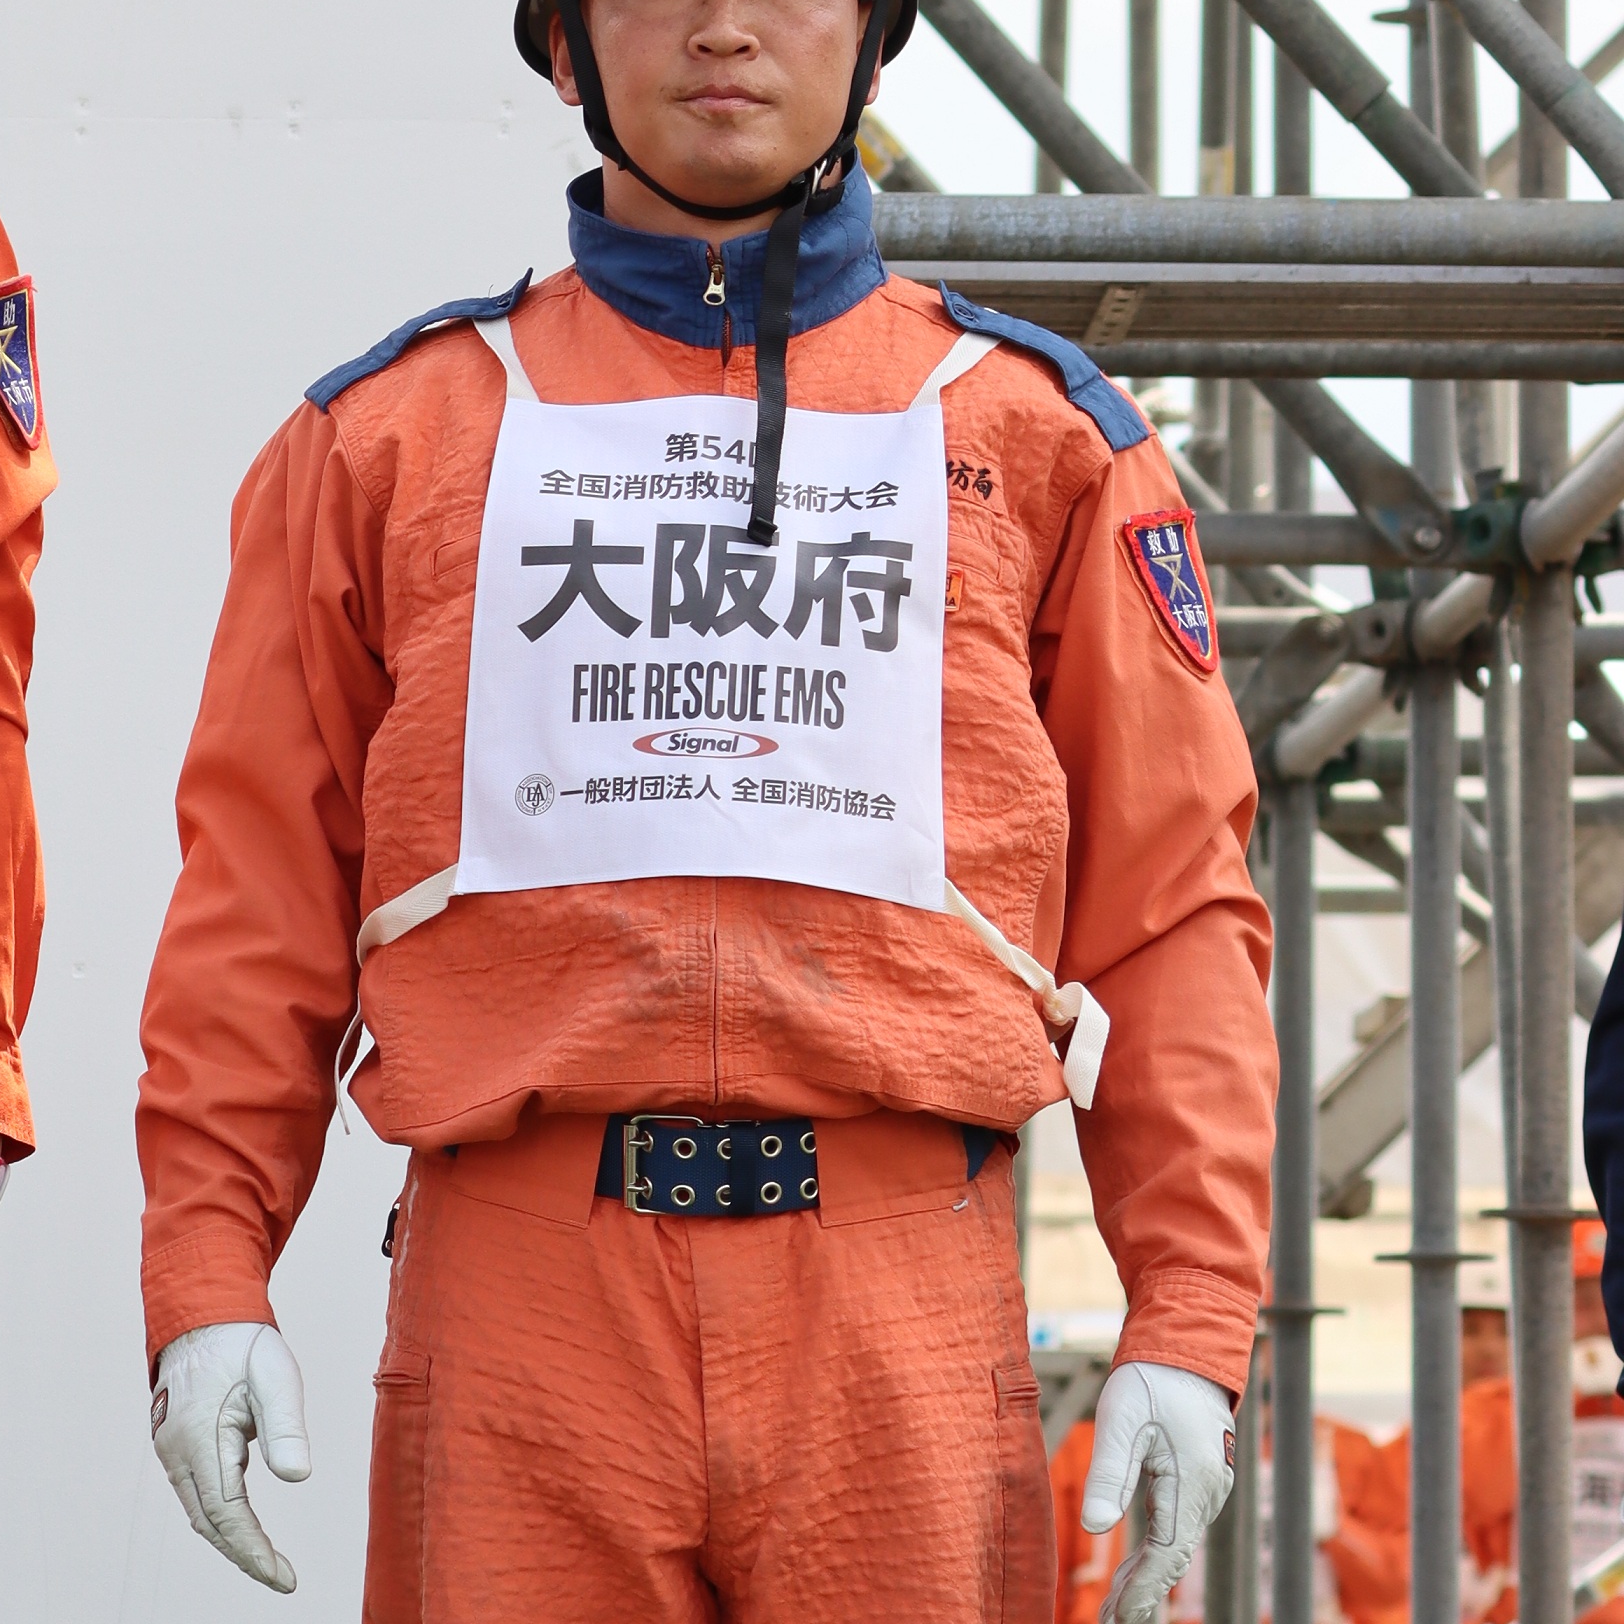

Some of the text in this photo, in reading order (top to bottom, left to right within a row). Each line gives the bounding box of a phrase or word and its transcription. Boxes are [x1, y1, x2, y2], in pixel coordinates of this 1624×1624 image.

[2, 376, 34, 408] 大阪市
[1146, 526, 1180, 556] 救助
[516, 518, 914, 653] 大阪府
[1172, 603, 1208, 630] 大阪市
[571, 660, 846, 730] FIRE RESCUE EMS
[667, 732, 740, 754] Signal
[559, 774, 722, 805] 一般財団法人
[730, 777, 898, 822] 全国消防協会
